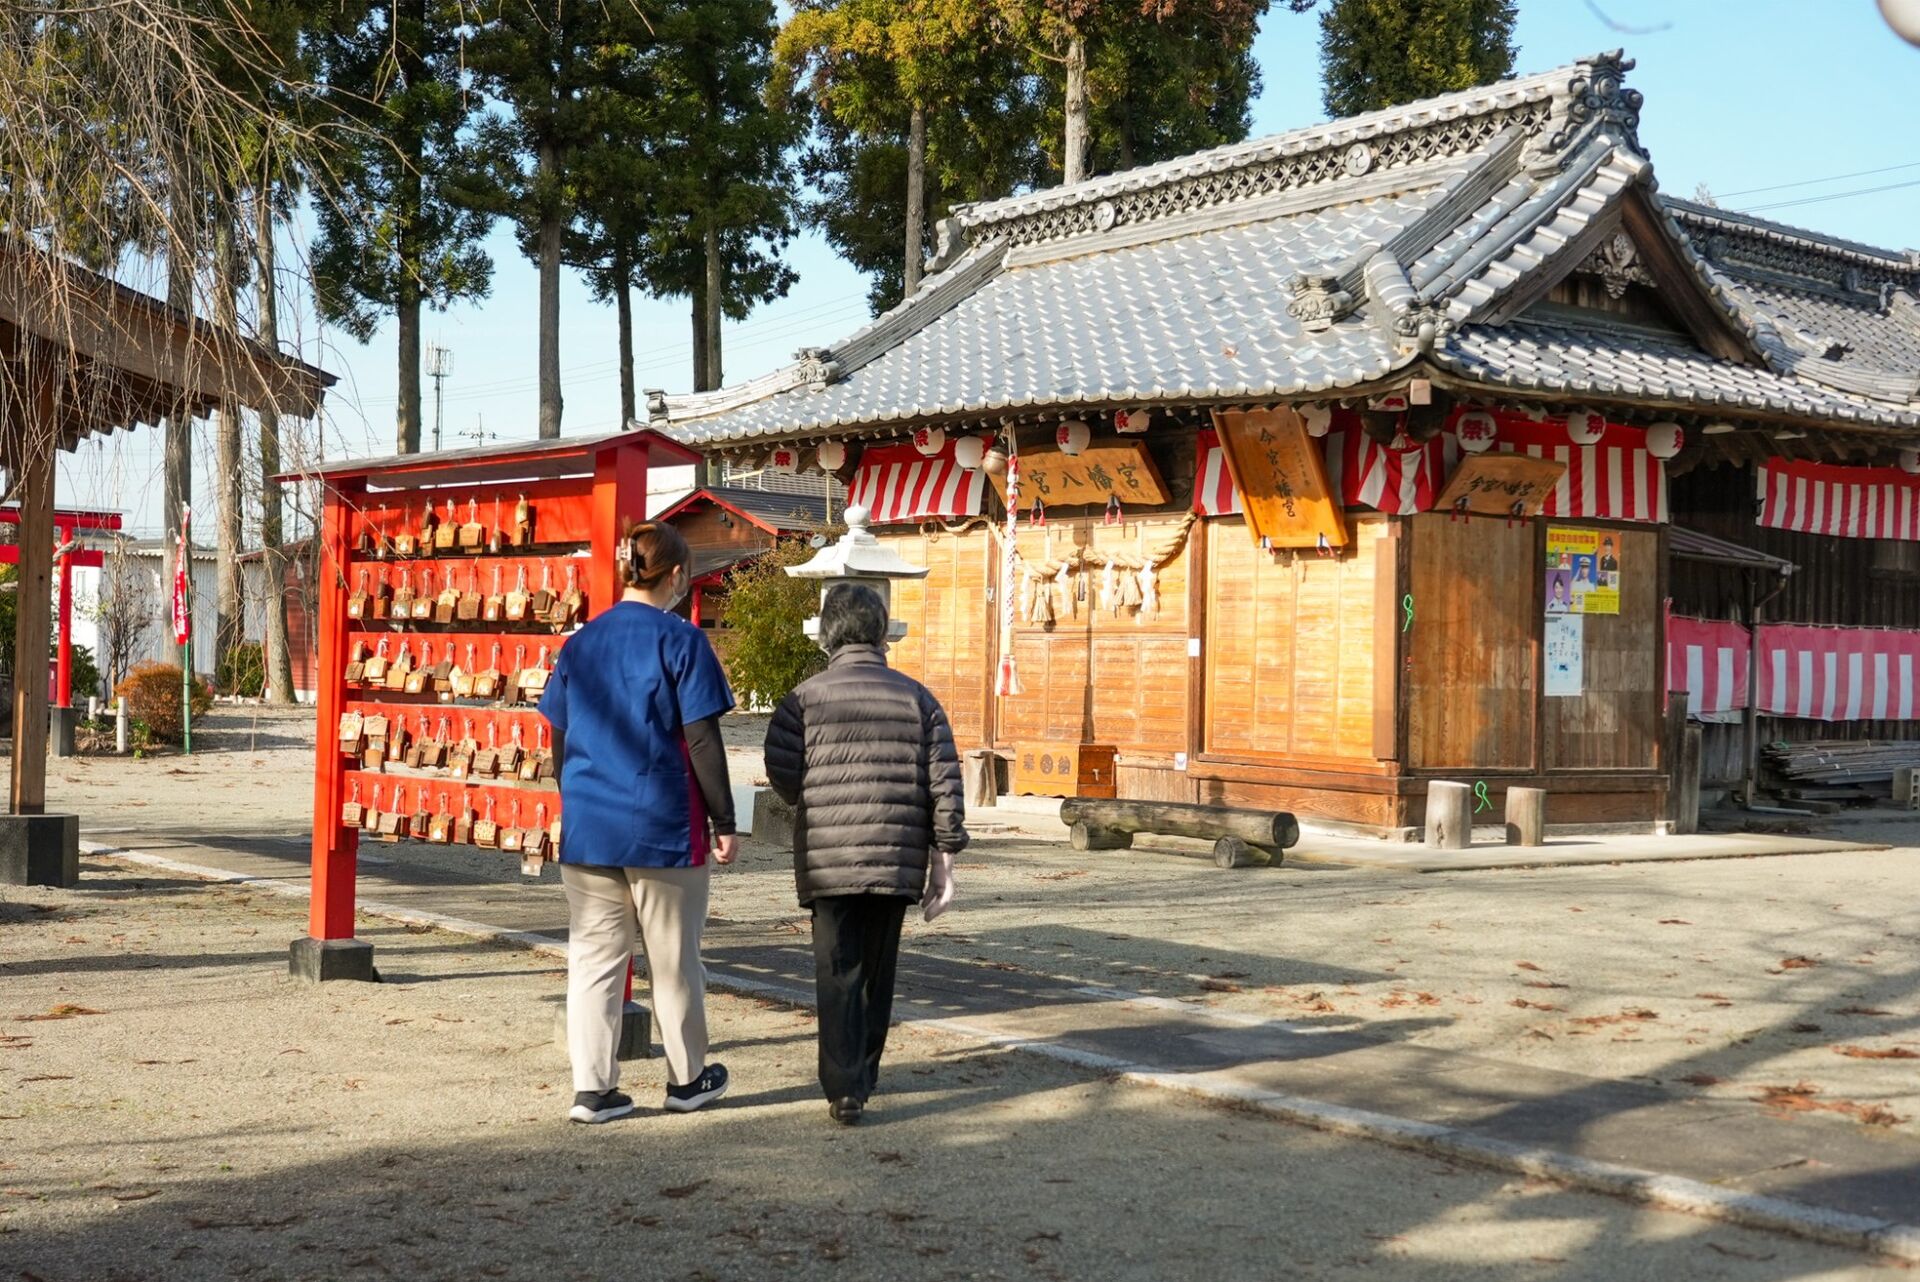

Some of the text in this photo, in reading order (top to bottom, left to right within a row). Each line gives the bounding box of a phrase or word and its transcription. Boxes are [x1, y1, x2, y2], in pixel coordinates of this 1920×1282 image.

[1462, 419, 1484, 441] 祭
[1586, 414, 1604, 435] 祭
[774, 451, 792, 467] 祭
[1260, 427, 1296, 518] 今宮八幡宮
